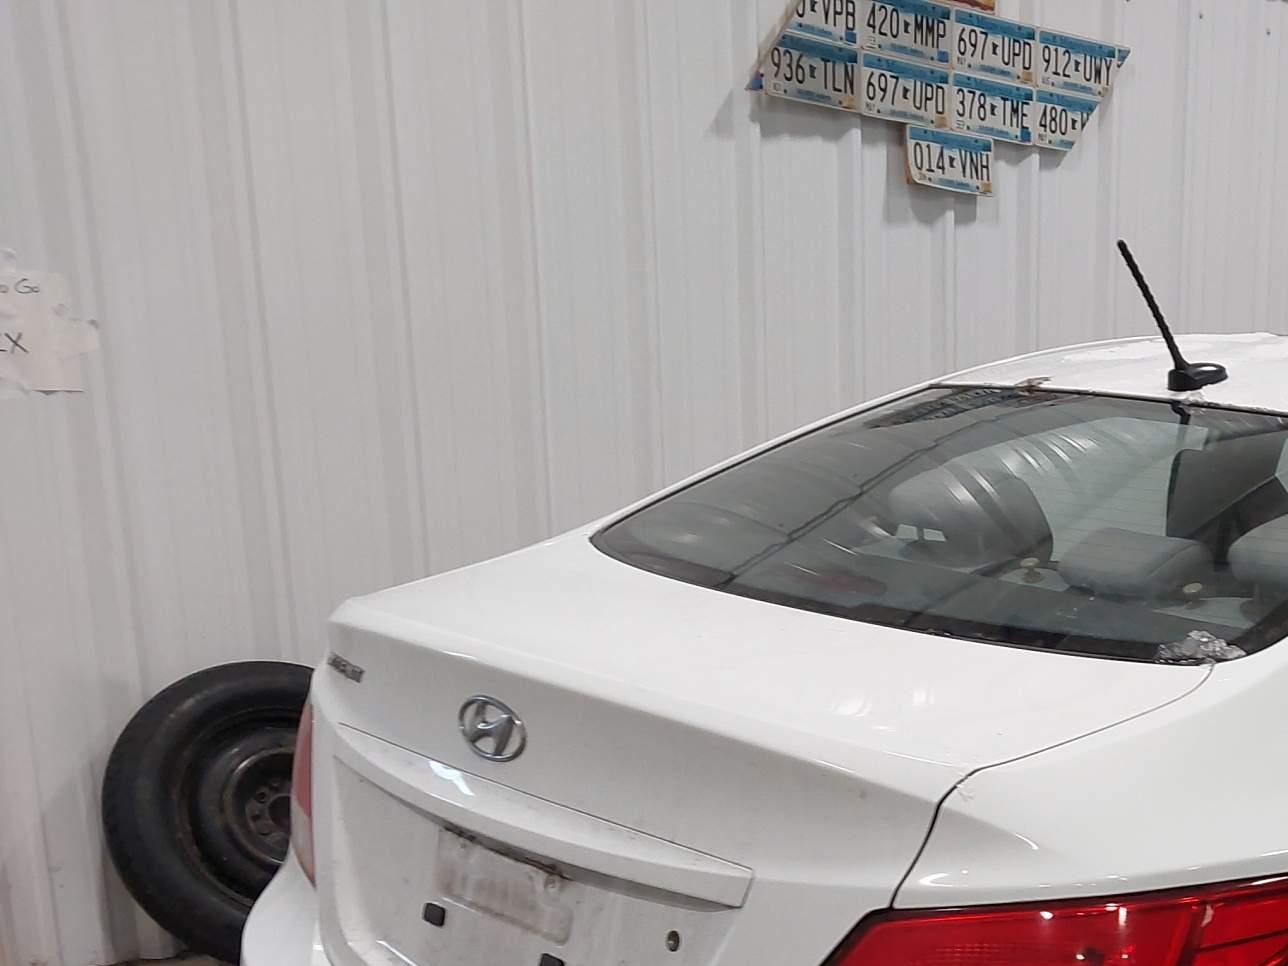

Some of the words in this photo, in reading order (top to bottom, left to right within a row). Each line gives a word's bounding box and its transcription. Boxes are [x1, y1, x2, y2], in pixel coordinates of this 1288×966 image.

[822, 0, 856, 32] VPB
[866, 3, 900, 39] 420
[913, 14, 947, 49] MMP
[957, 28, 989, 61] 697
[770, 47, 806, 85] 936
[820, 58, 855, 96] TLN
[1042, 46, 1072, 79] 912
[1083, 54, 1113, 86] UWY
[866, 71, 899, 106] 697
[956, 88, 987, 121] 378
[1000, 97, 1031, 130] TME
[1038, 105, 1068, 136] 480
[913, 141, 946, 175] 014
[958, 147, 990, 182] VNH
